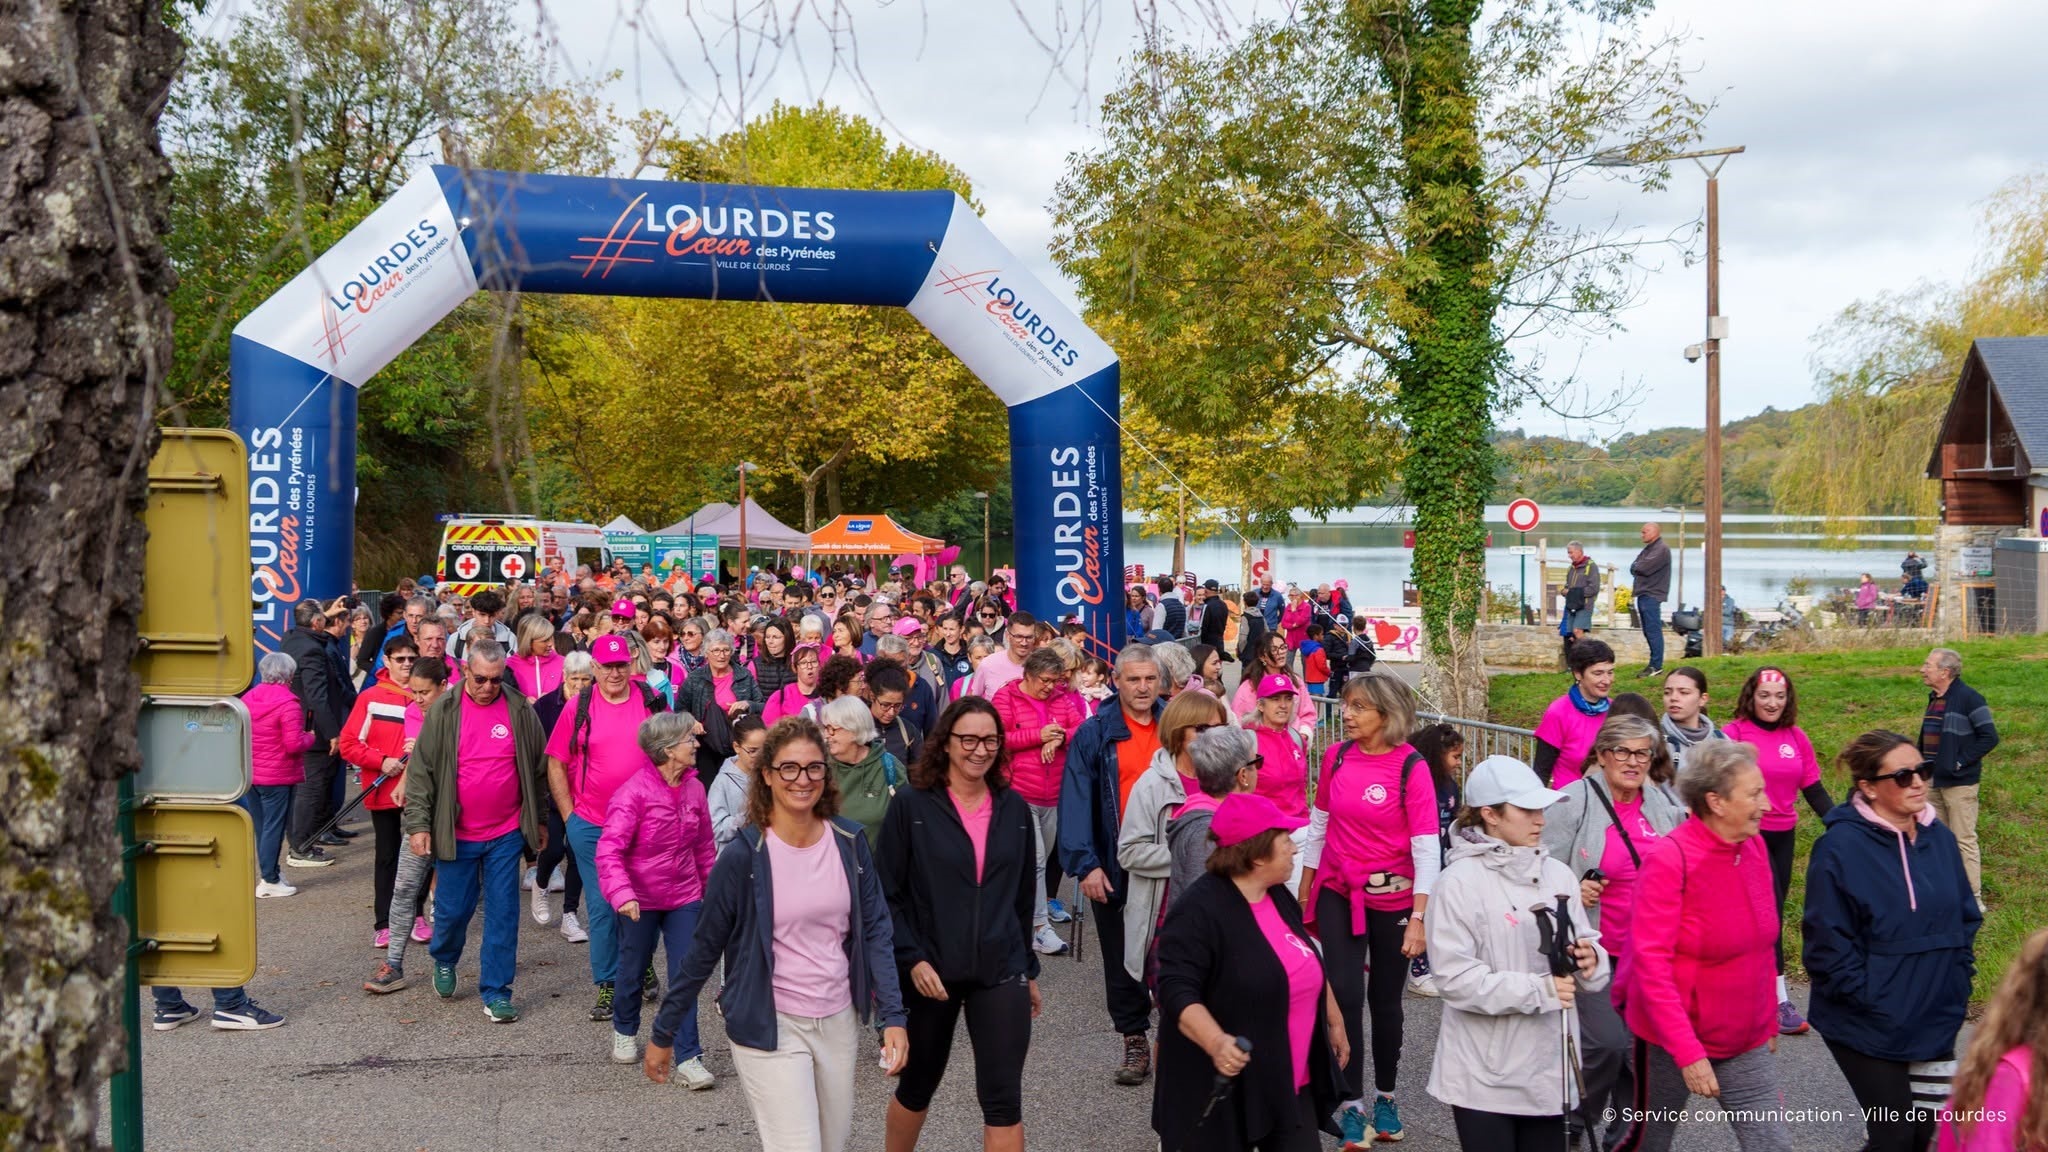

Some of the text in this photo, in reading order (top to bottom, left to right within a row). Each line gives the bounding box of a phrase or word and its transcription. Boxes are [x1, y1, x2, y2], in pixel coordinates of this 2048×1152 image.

[405, 261, 419, 275] des
[417, 237, 448, 263] Pyrénées
[647, 203, 836, 241] LOURDES
[665, 217, 836, 261] Cœur des Pyrénées
[330, 219, 438, 311] LOURDES
[716, 261, 790, 272] VILLE DE LOURDES
[986, 277, 1078, 367] LOURDES
[1026, 340, 1037, 353] des
[250, 427, 282, 621] LOURDES
[260, 427, 304, 603] Cœur des Pyrénées
[305, 474, 316, 551] VILLE DE LOURDES
[1050, 446, 1084, 623] LOURDES
[1067, 445, 1103, 605] Cœur des Pyrénées
[1103, 522, 1109, 534] DE
